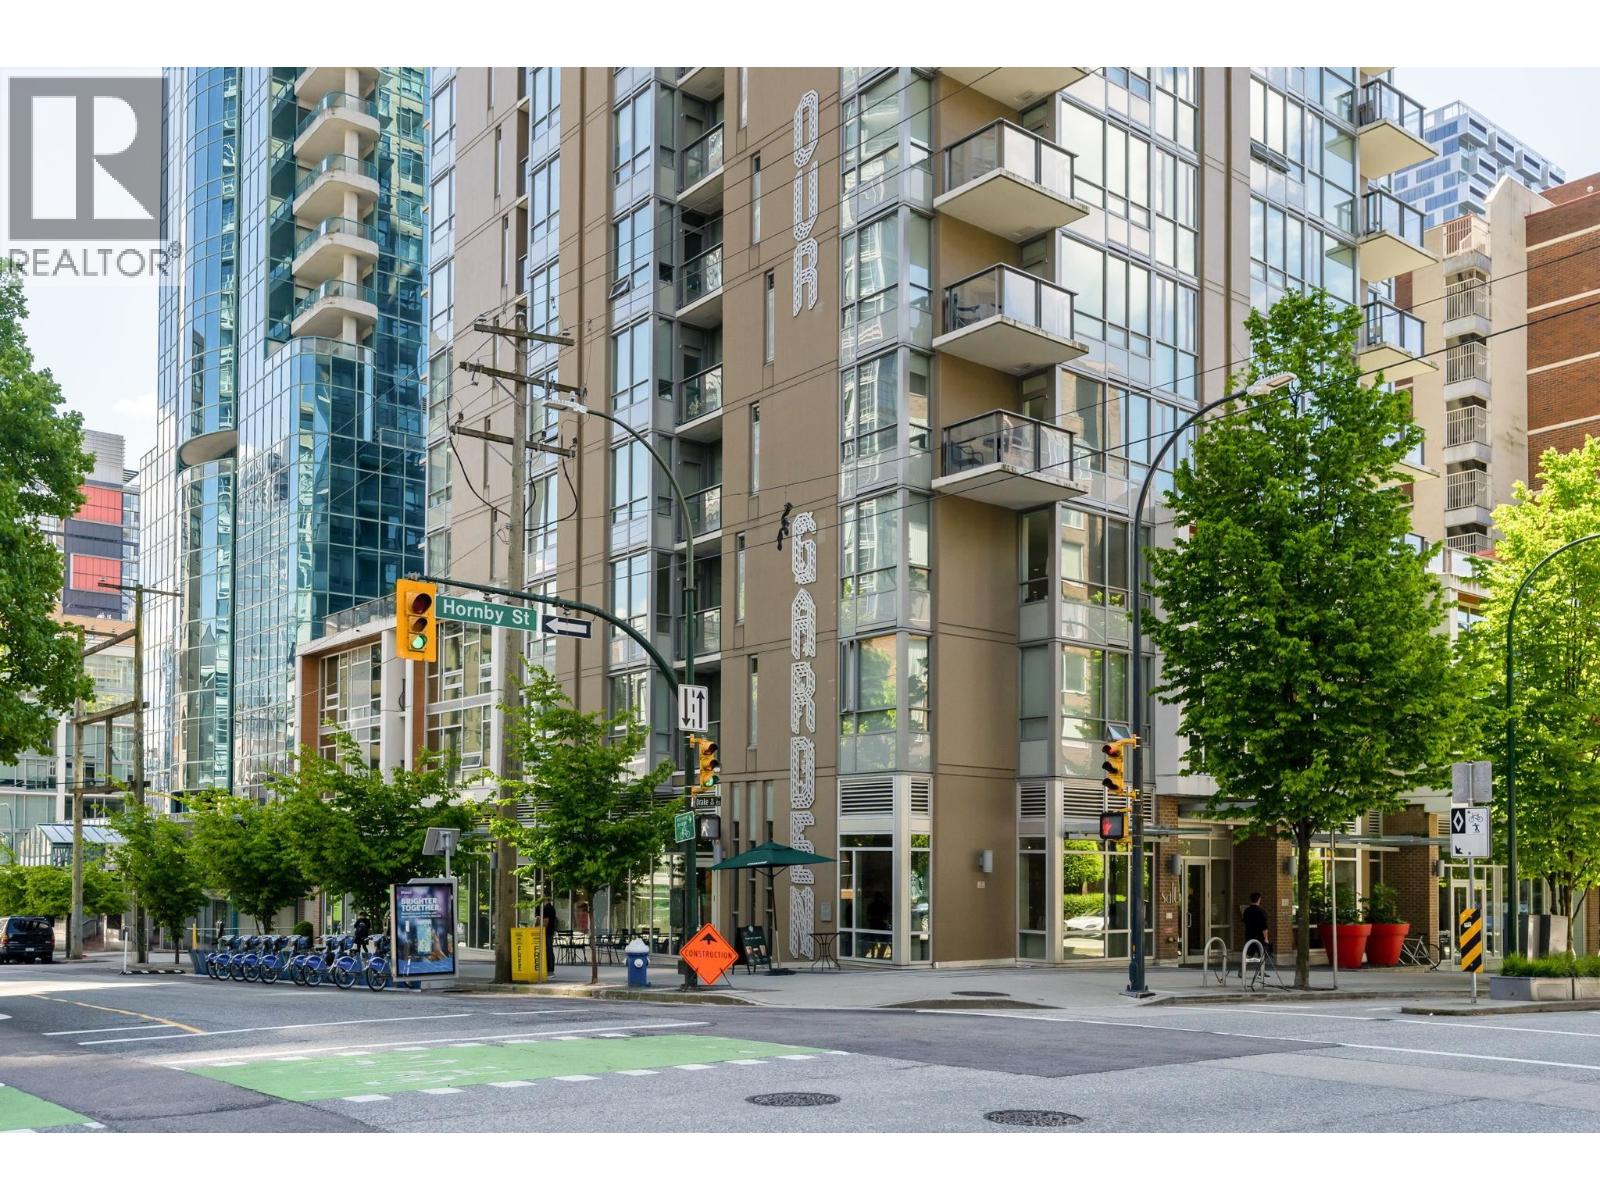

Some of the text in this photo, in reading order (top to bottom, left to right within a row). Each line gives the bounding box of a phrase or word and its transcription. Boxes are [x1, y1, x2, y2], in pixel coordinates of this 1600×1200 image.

[793, 88, 818, 318] OUR
[443, 599, 530, 625] Hornby St
[791, 511, 817, 960] GARDEN
[401, 897, 438, 905] BRIGHTER
[685, 949, 733, 959] CONSTRUCTION
